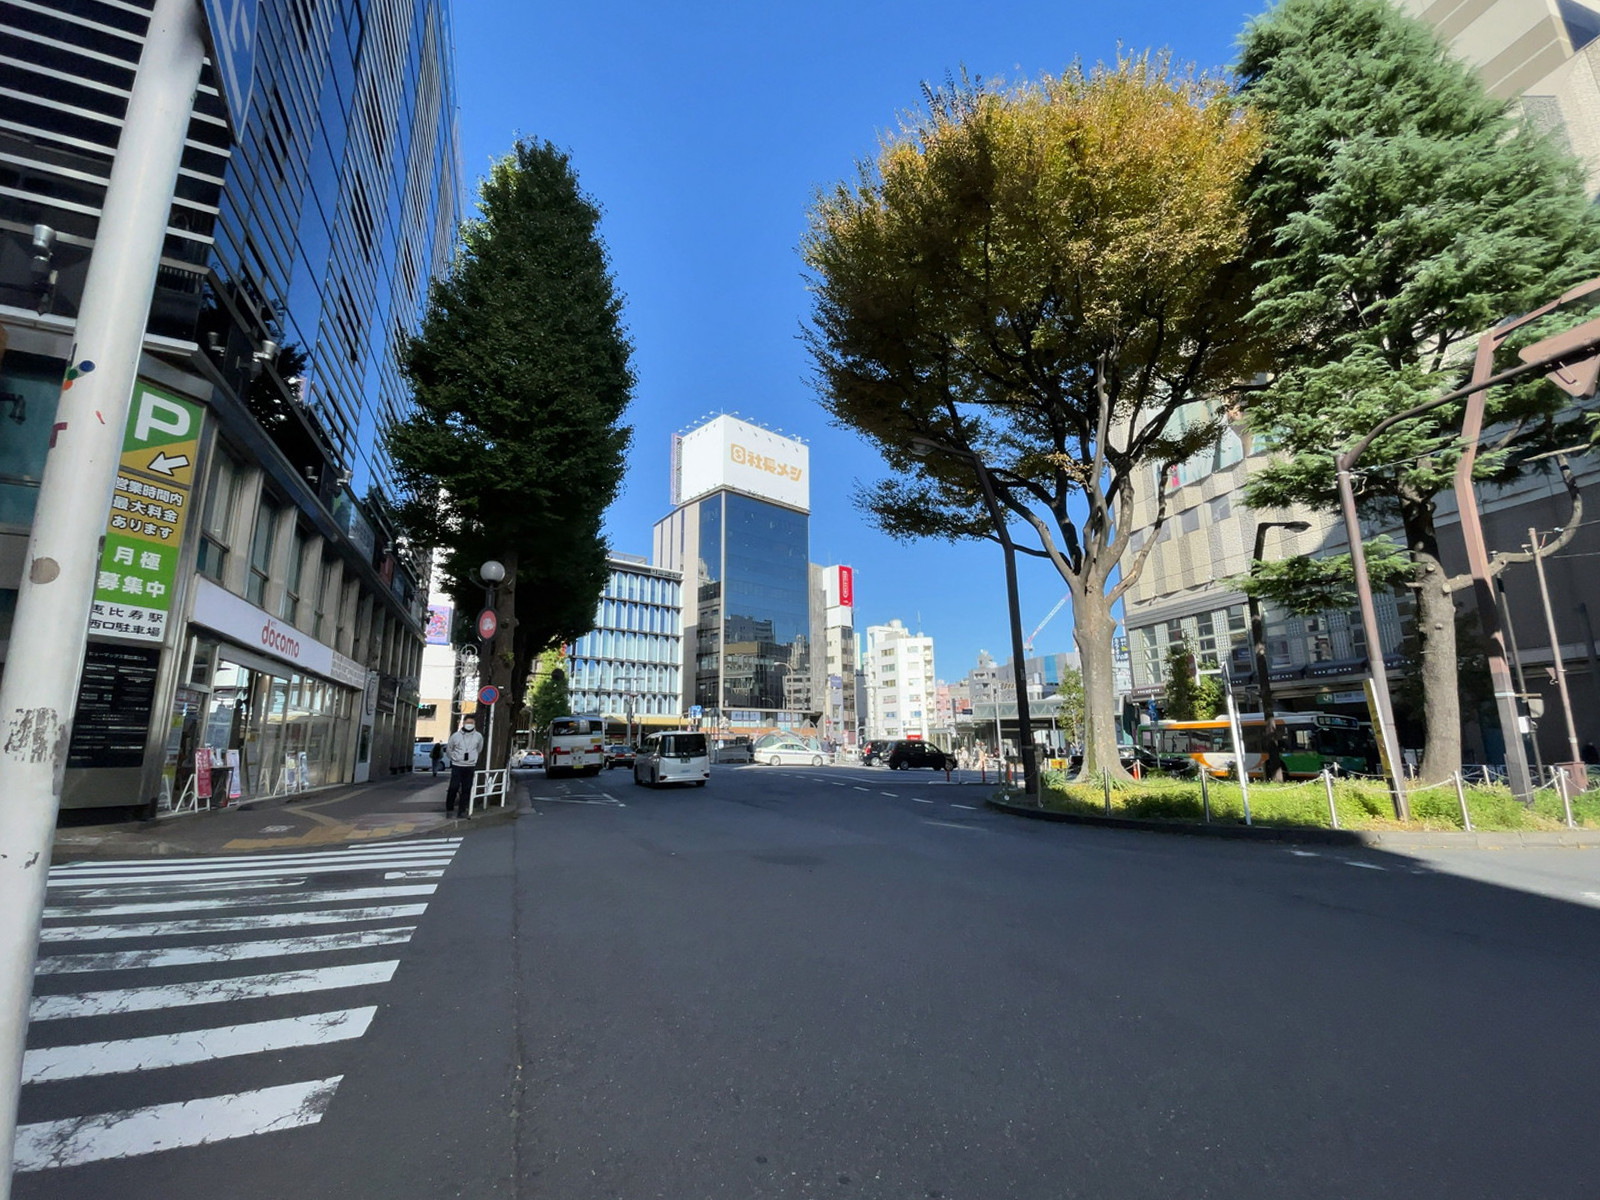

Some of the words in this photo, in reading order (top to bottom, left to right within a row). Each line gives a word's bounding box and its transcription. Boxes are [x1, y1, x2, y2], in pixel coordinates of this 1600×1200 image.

[134, 391, 191, 441] P
[115, 476, 183, 507] 営業時間内
[112, 495, 178, 523] 最大料金
[111, 515, 173, 539] あります
[113, 546, 162, 571] 月極
[98, 571, 166, 598] 募集中
[89, 619, 161, 637] 西口駐車場
[261, 619, 300, 658] docomo
